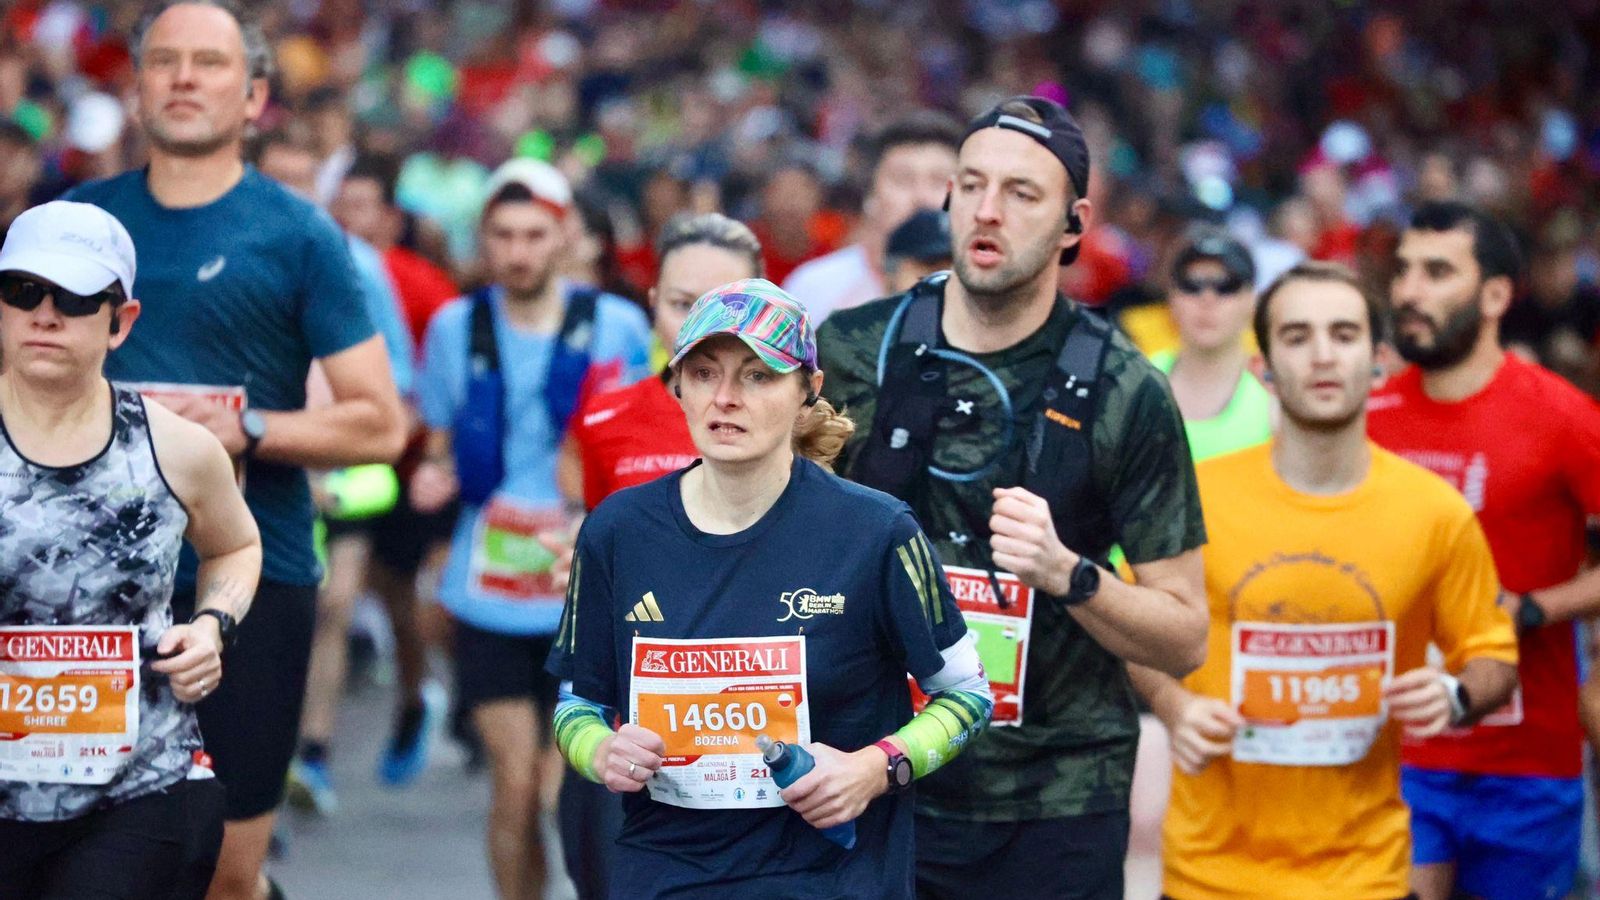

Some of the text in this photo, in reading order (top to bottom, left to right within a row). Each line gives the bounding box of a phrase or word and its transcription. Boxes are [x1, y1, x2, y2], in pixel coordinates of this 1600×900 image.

[7, 635, 122, 658] GENERALI
[669, 648, 788, 673] GENERALI
[0, 684, 98, 713] 12659
[1268, 674, 1361, 703] 11965
[24, 715, 68, 727] SHEREE
[663, 702, 767, 732] 14660
[695, 735, 739, 746] BOZENA
[751, 769, 769, 778] 21
